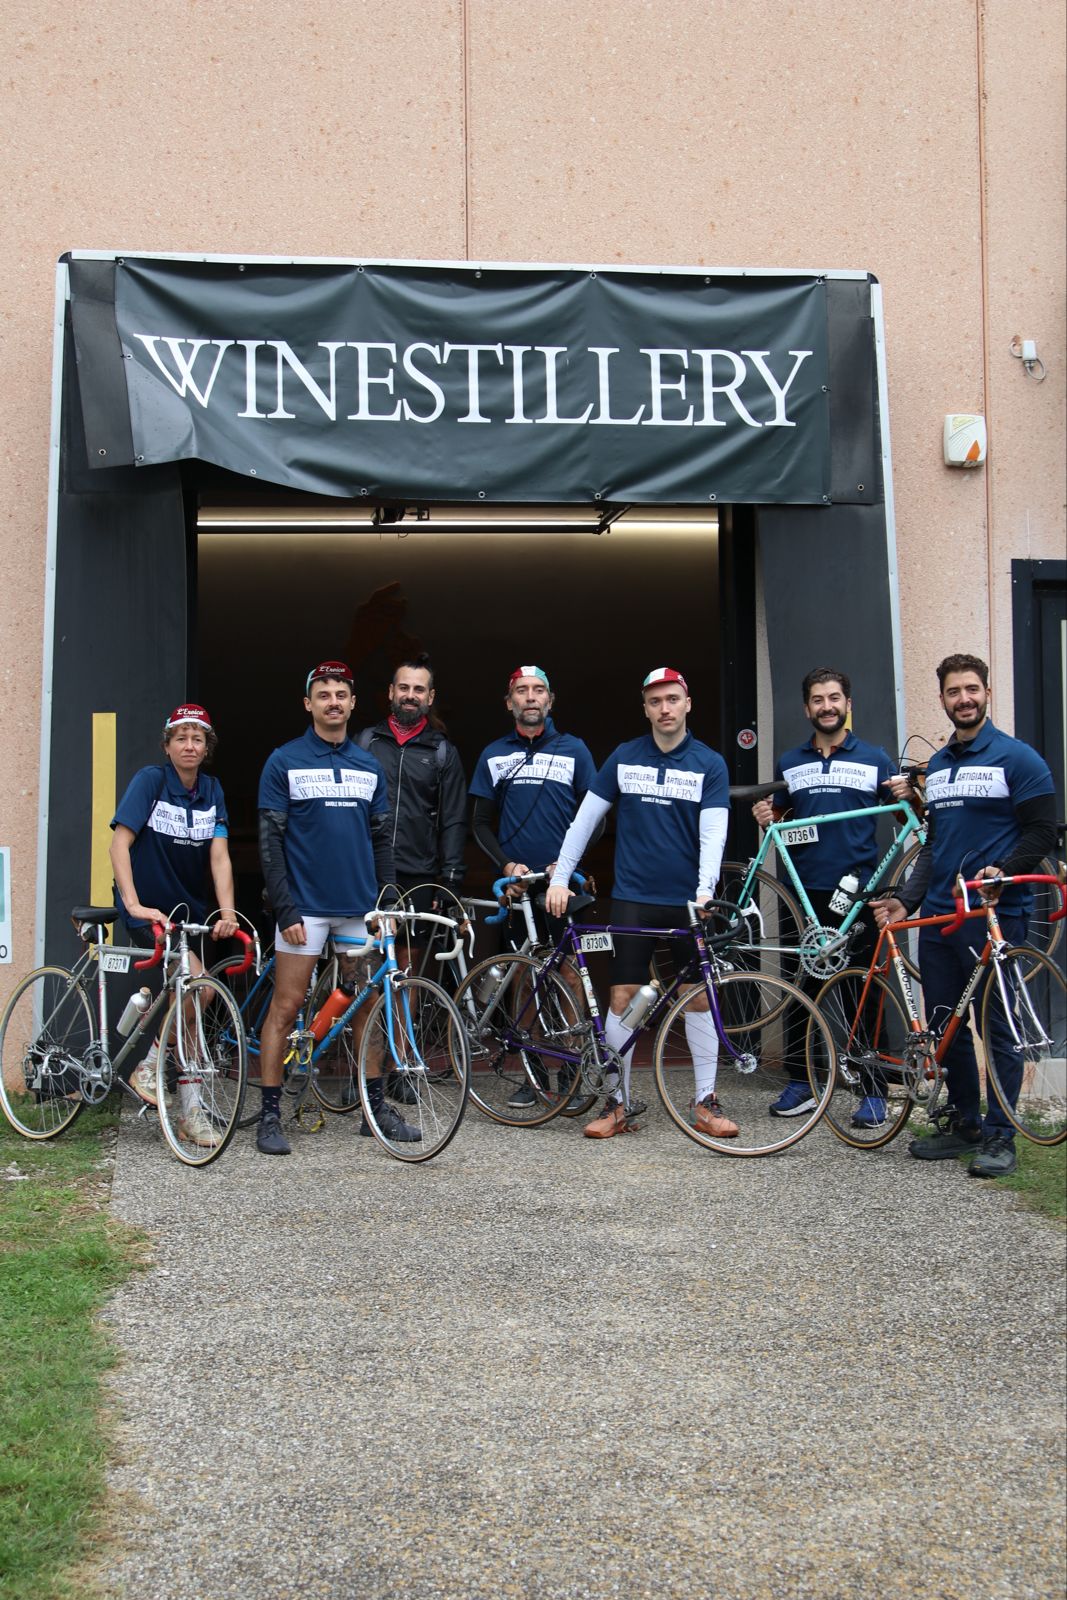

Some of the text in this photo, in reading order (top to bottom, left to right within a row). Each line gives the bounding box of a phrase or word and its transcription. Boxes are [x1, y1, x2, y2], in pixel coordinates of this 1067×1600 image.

[133, 333, 813, 428] WINESTILLERY
[624, 771, 655, 782] DISTILLERIA
[832, 766, 867, 777] ARTIGIANA
[956, 772, 993, 781] ARTIGIANA
[294, 774, 332, 784] DISTILLERIA
[666, 775, 697, 787] ARTIGIANA
[788, 829, 809, 843] 8736
[586, 937, 603, 949] 8730
[107, 957, 123, 970] 8737
